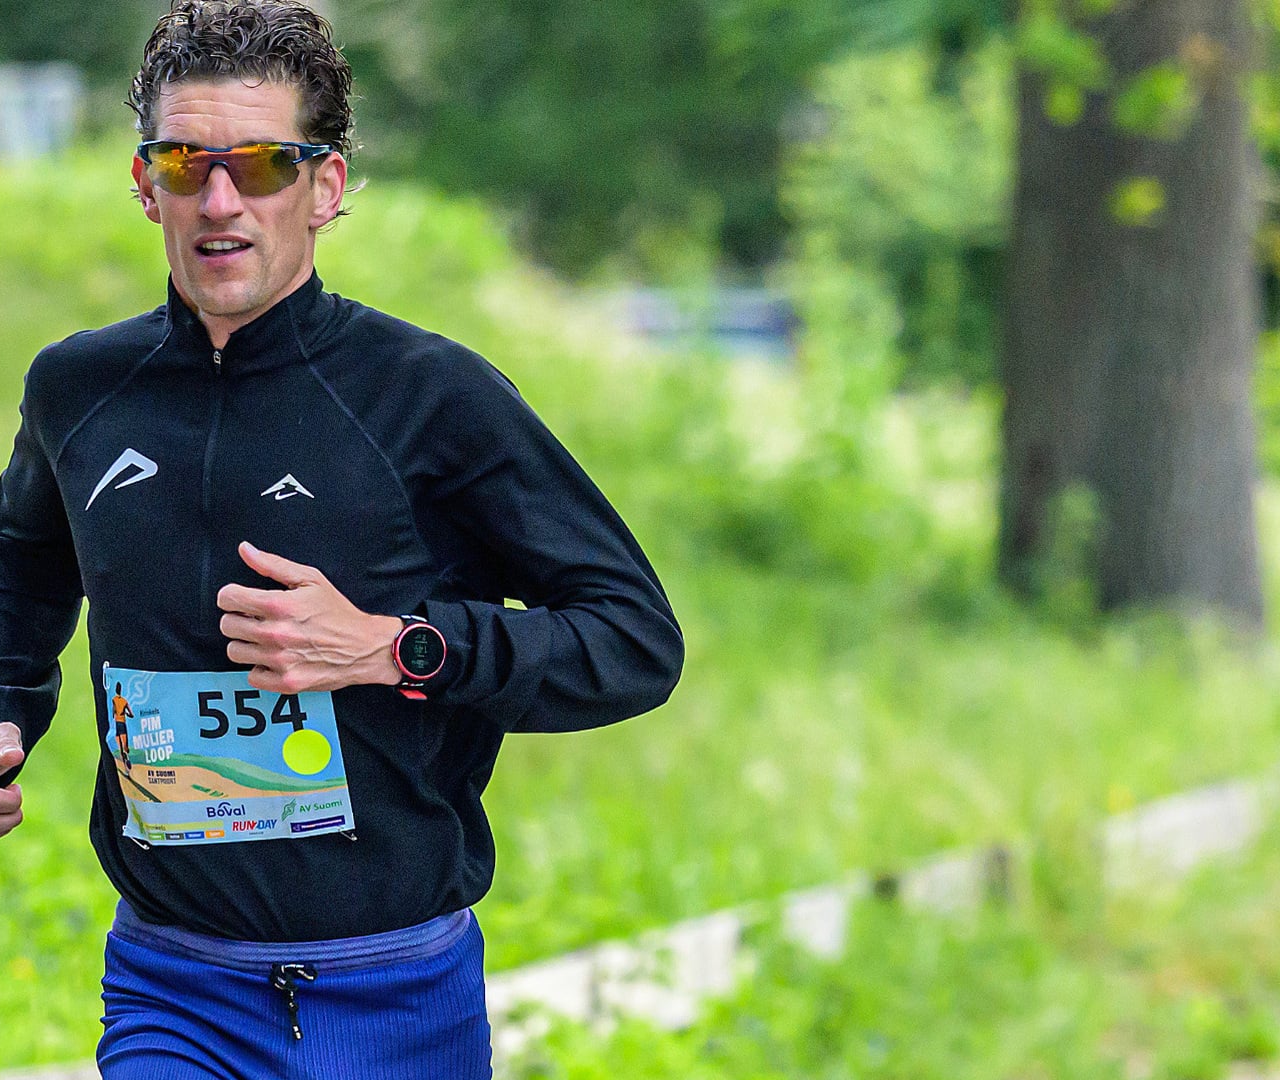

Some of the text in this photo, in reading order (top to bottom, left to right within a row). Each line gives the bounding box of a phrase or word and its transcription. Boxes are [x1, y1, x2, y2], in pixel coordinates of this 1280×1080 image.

[198, 690, 308, 739] 554
[141, 715, 161, 733] PIM
[133, 729, 174, 749] MULIER
[145, 745, 173, 763] LOOP
[206, 802, 246, 818] Boval
[299, 799, 343, 813] AV Suomi
